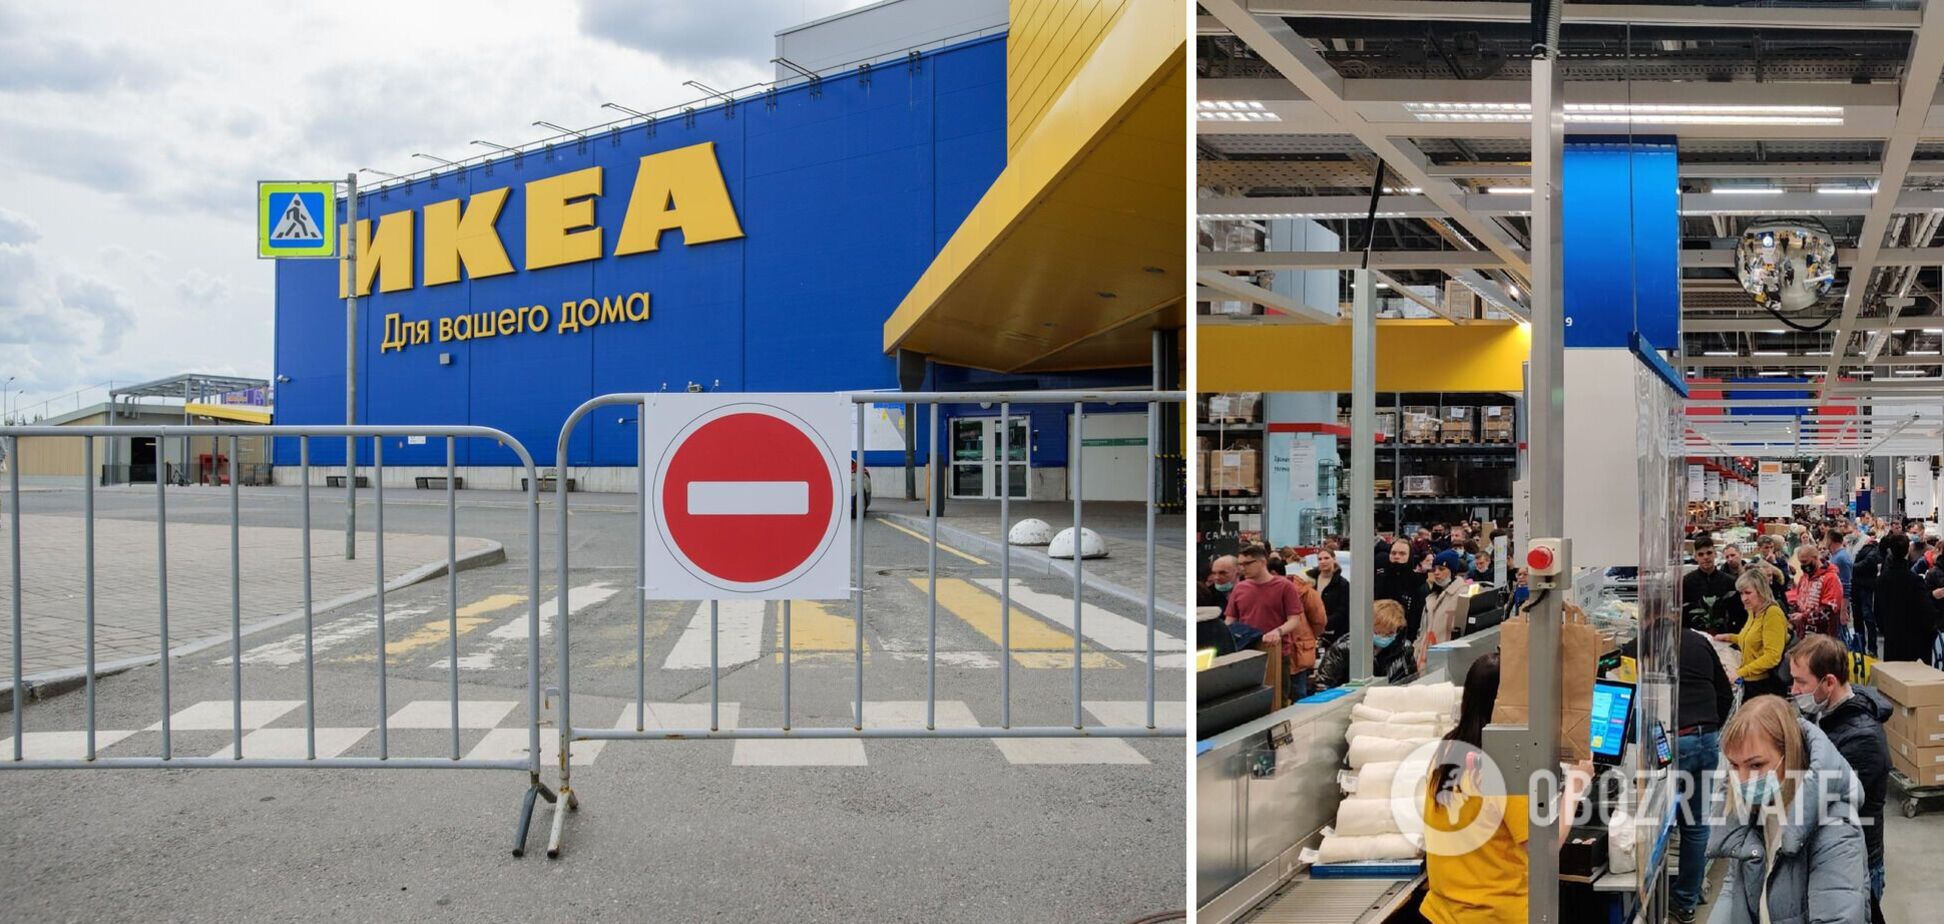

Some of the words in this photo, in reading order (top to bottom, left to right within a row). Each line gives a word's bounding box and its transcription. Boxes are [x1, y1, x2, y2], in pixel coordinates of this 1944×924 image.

[339, 142, 745, 299] ИКЕА
[381, 313, 429, 353] Для
[439, 304, 549, 343] вашего
[558, 292, 651, 333] дома
